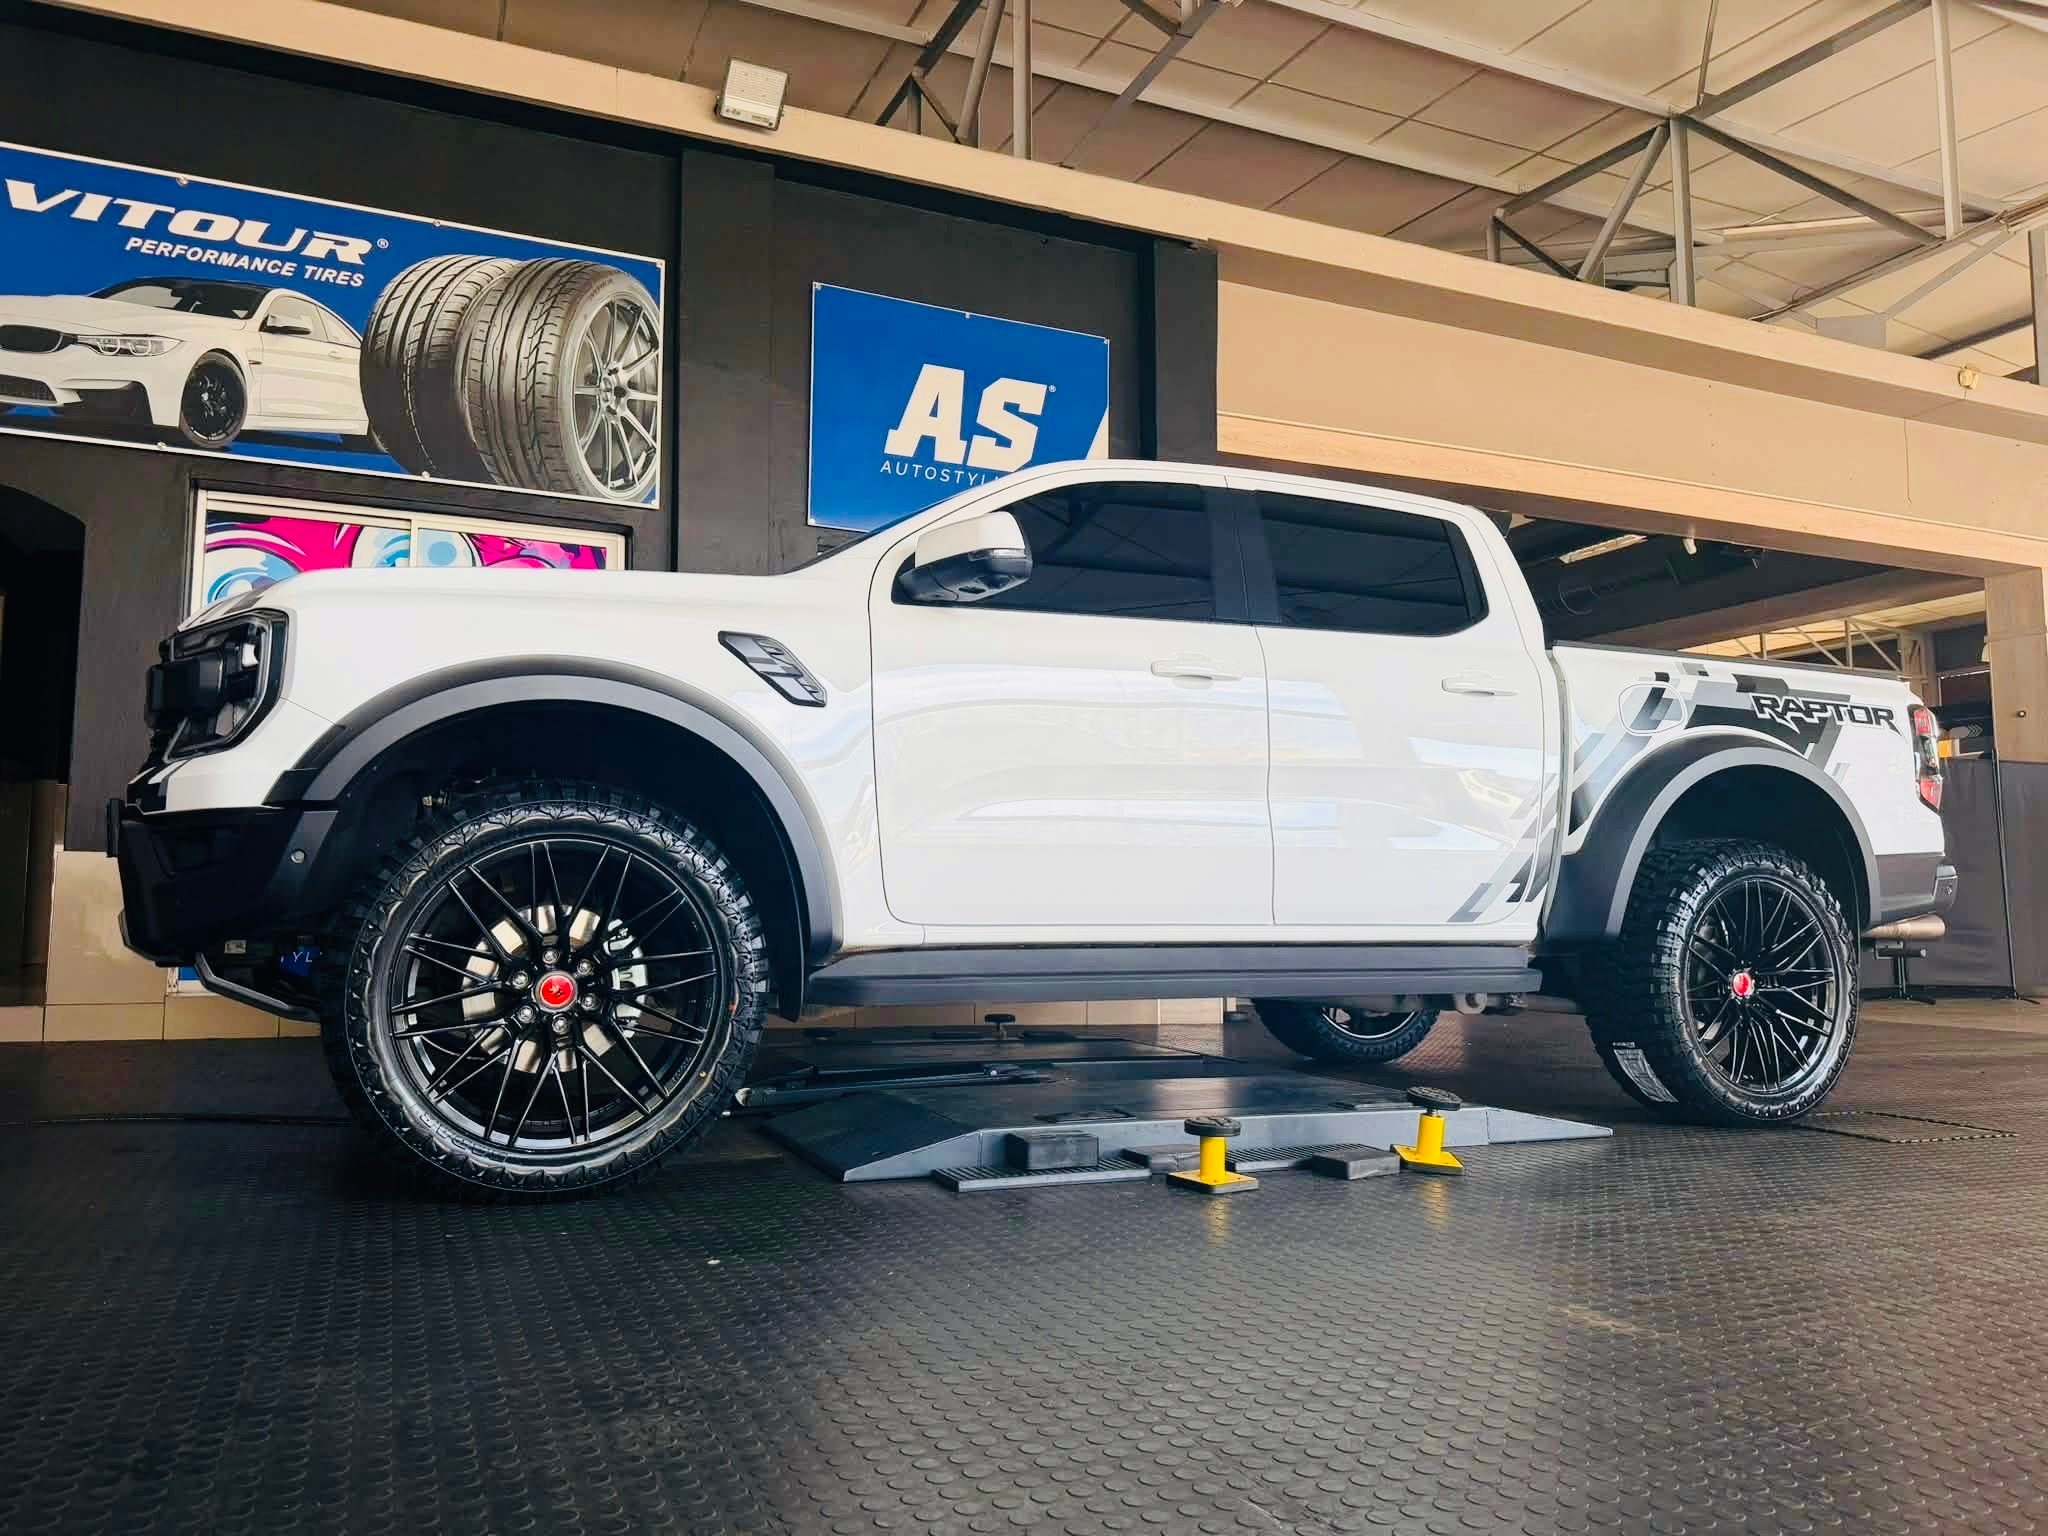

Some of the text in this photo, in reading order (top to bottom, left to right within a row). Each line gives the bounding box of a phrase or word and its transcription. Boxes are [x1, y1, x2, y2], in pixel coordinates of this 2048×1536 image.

[5, 178, 374, 266] VITOUR
[124, 236, 366, 288] PERFORMANCE TIRES
[884, 363, 1048, 473] AS
[880, 459, 1000, 487] AUTOSTYL
[1751, 694, 1904, 737] RAPTOR
